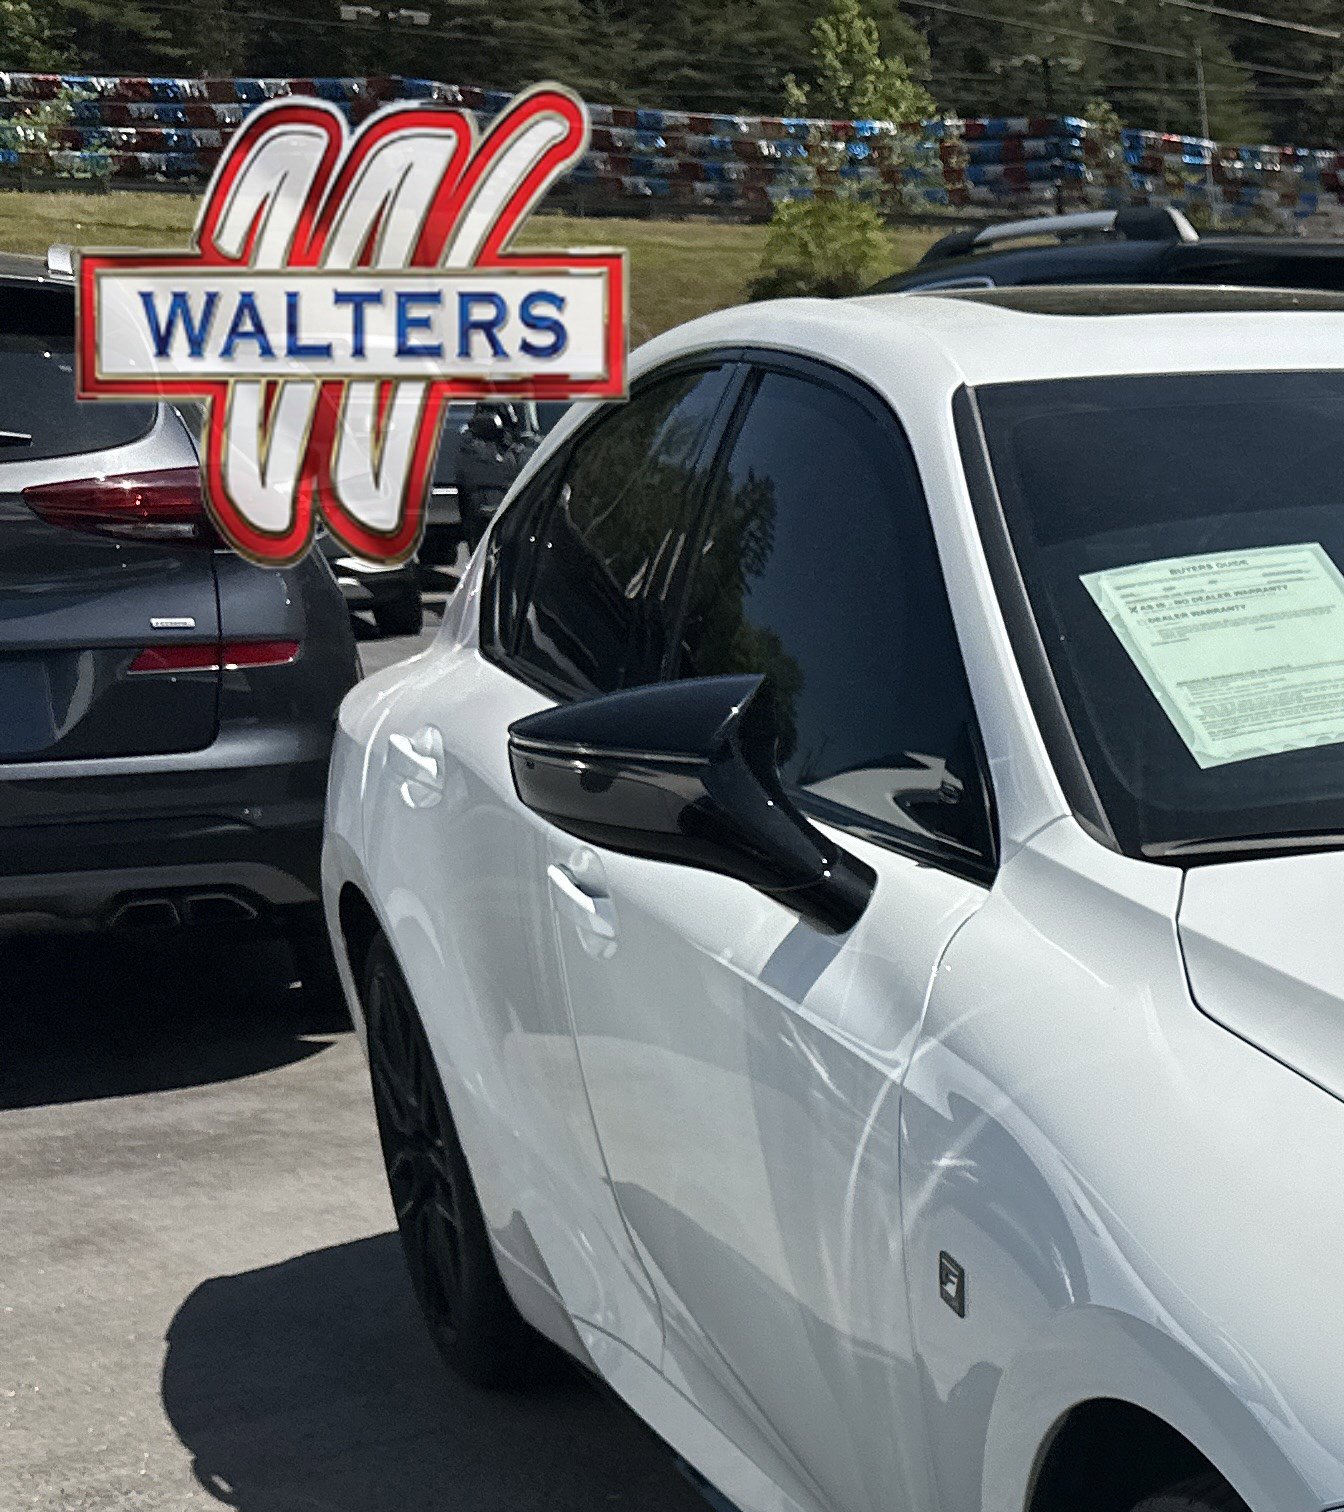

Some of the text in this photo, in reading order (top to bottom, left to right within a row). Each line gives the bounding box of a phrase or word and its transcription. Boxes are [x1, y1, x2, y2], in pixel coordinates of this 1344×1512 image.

[1191, 592, 1231, 602] DEALER
[1233, 584, 1288, 597] WARRANTY
[1148, 604, 1246, 623] DEALER WARRANTY
